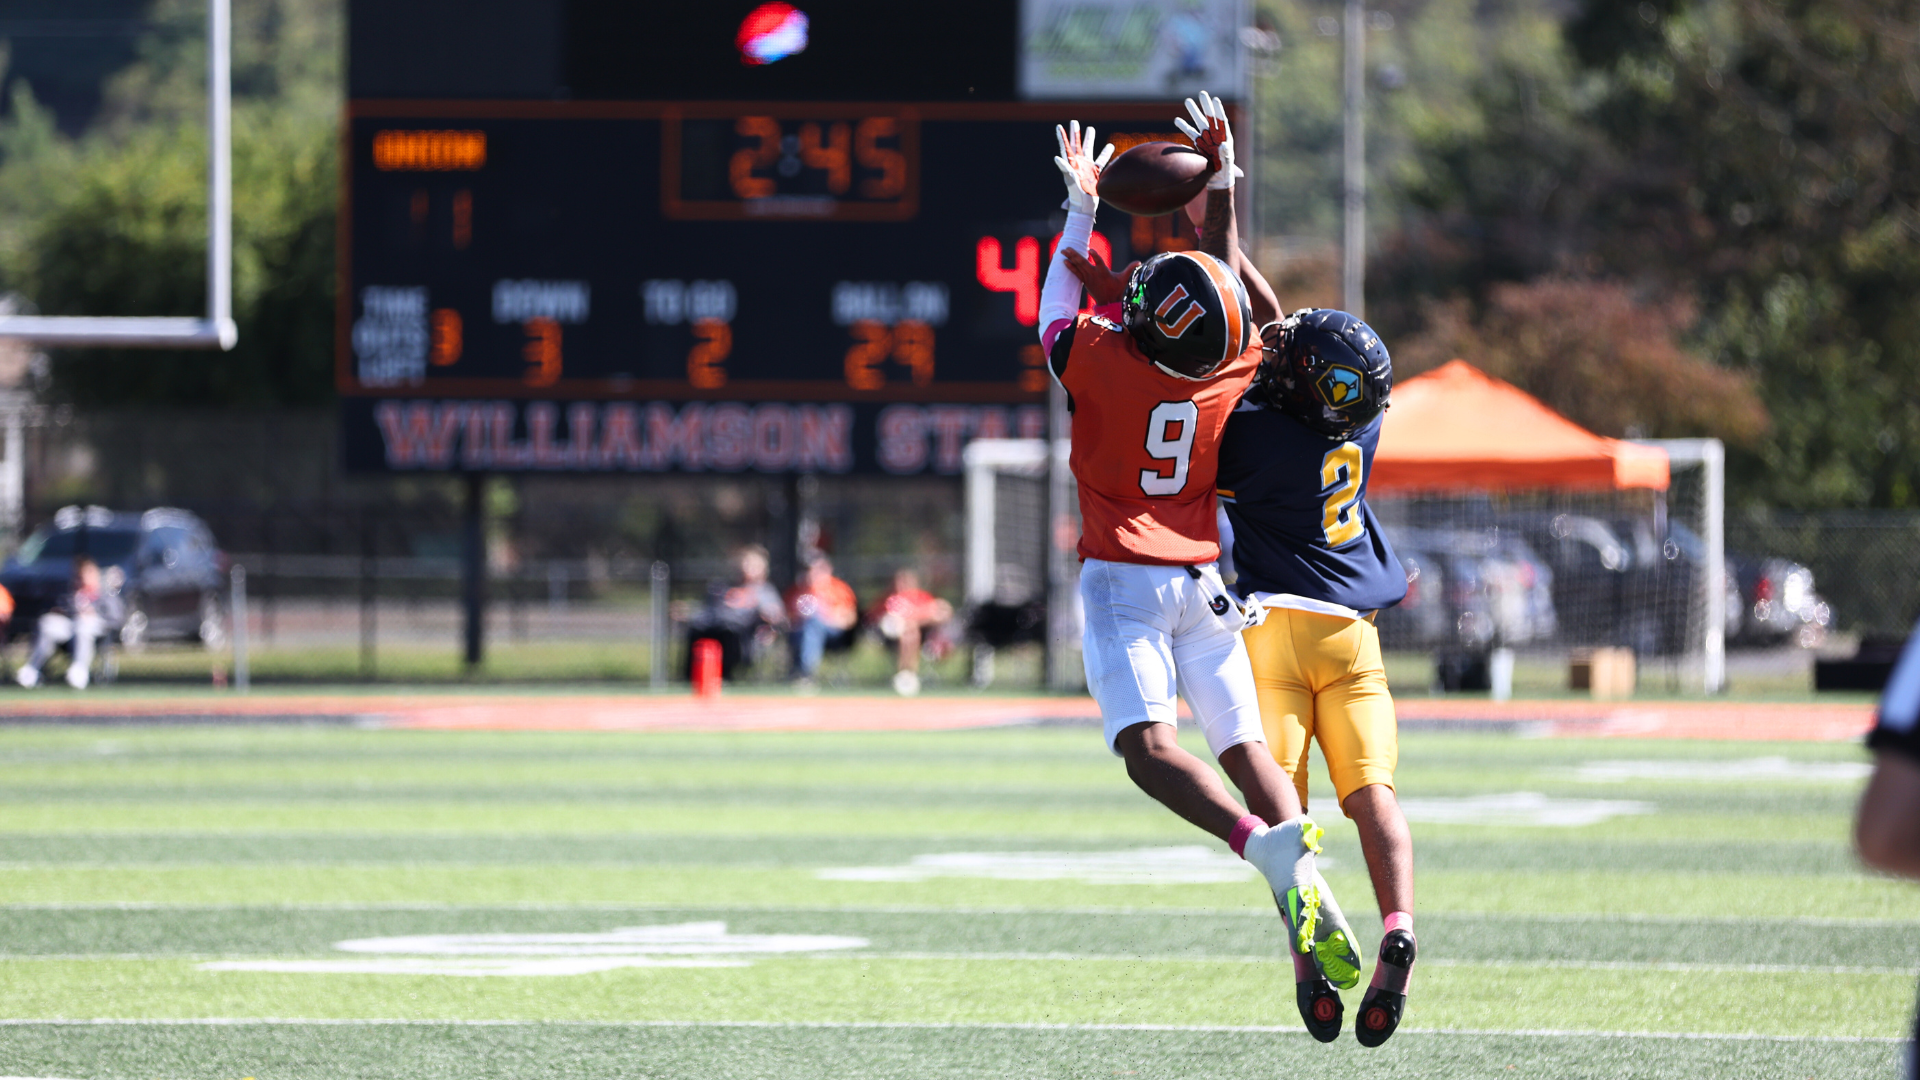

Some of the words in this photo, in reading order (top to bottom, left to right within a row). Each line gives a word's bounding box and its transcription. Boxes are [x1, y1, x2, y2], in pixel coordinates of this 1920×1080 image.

[730, 115, 906, 199] 2:45
[361, 284, 429, 319] TIME
[491, 278, 590, 324] DOWN
[641, 278, 685, 325] TO
[686, 278, 738, 325] GO
[831, 280, 900, 326] BALL
[901, 280, 950, 326] ON
[1154, 283, 1207, 339] U
[522, 316, 563, 388] 3
[687, 317, 732, 389] 2
[844, 318, 935, 390] 29
[375, 403, 852, 472] WILLIAMSON
[1139, 399, 1199, 497] 9
[1319, 441, 1364, 548] 2
